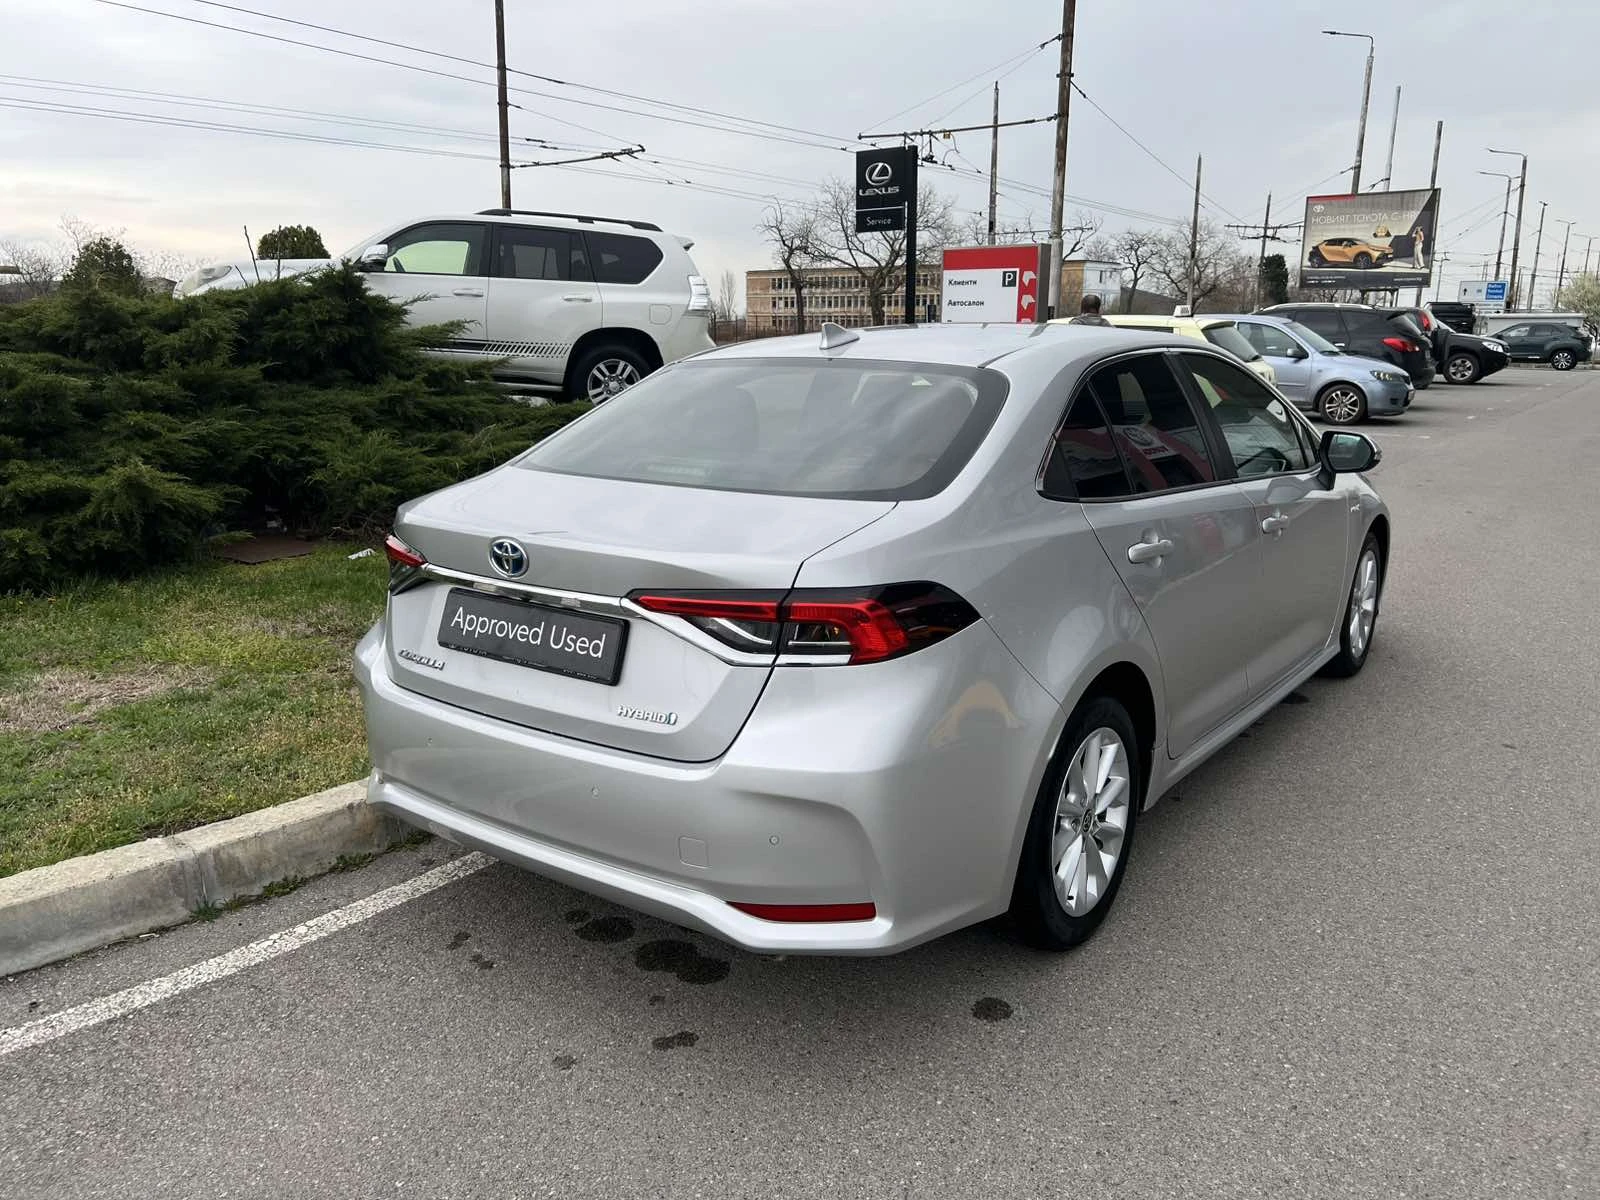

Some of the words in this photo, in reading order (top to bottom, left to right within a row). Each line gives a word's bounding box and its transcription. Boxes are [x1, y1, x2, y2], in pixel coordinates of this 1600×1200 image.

[858, 186, 900, 197] LEXUS
[866, 216, 892, 226] Service
[1311, 214, 1350, 225] НОВИЯТ
[1352, 212, 1389, 223] TOYOTA
[947, 299, 985, 307] Автосалон
[450, 606, 545, 646] Approved
[550, 624, 607, 659] Used
[616, 704, 668, 724] HYBRID
